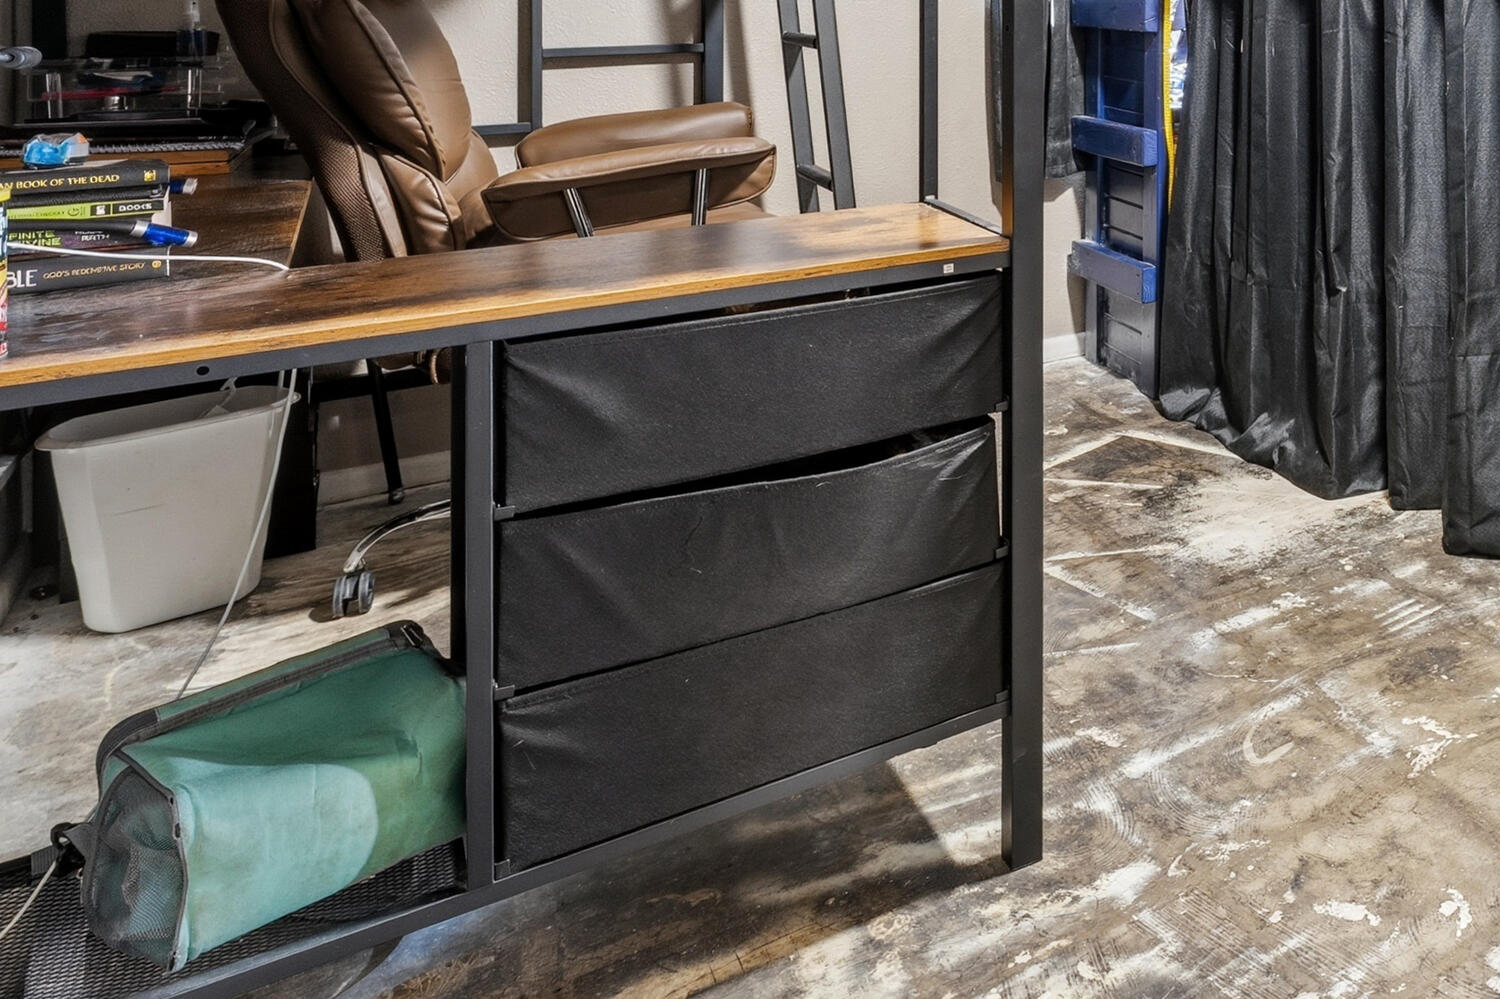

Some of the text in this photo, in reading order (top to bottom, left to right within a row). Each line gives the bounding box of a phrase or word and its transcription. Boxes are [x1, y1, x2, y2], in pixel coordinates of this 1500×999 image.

[16, 179, 48, 189] BOOK
[50, 178, 65, 187] OF
[67, 176, 87, 185] THE
[90, 174, 120, 184] DEAD
[119, 261, 146, 271] STORY
